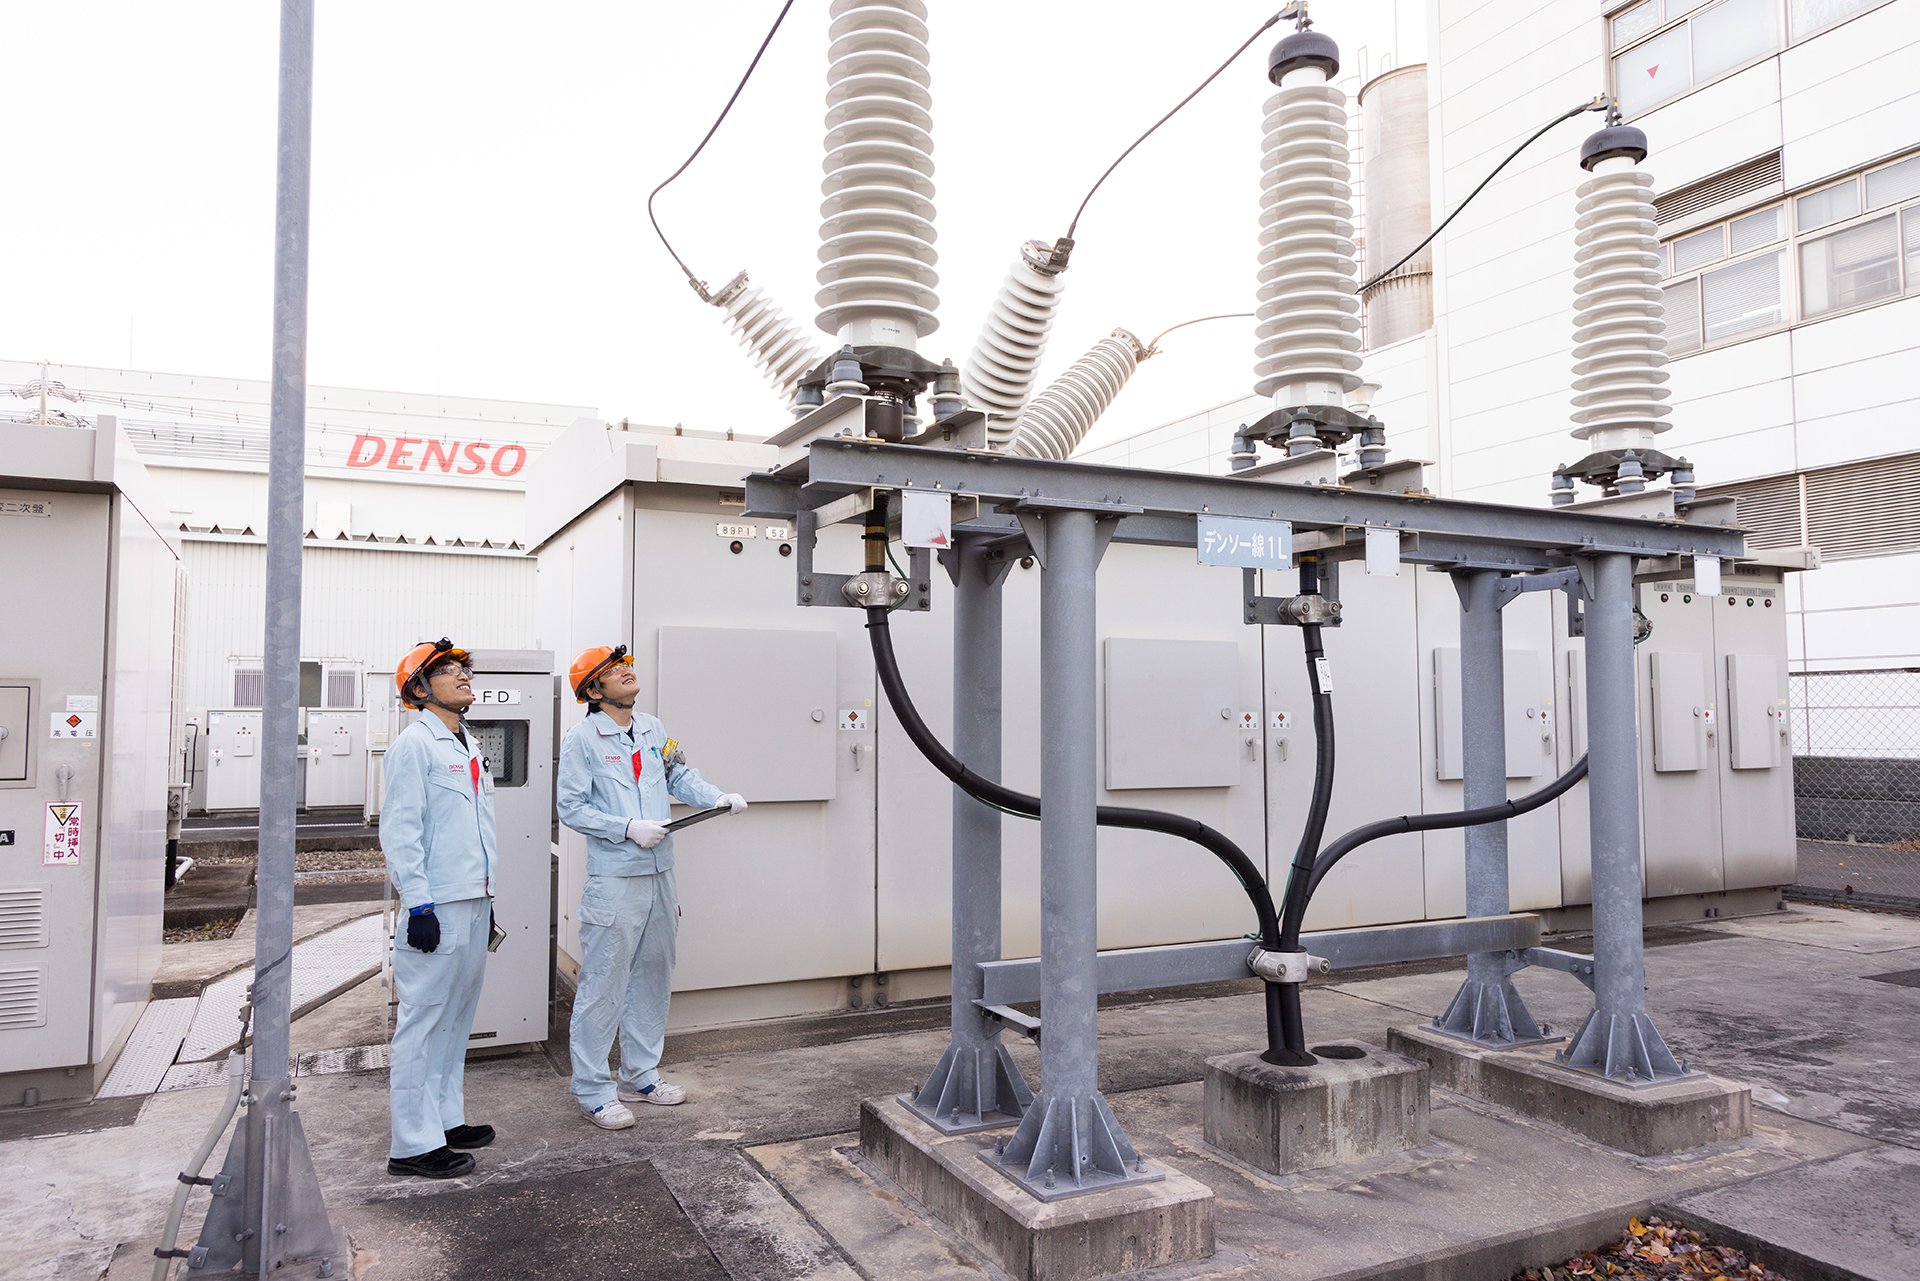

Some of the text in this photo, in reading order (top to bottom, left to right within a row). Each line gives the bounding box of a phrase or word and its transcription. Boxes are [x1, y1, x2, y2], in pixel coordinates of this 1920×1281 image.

[346, 434, 527, 477] DENSO
[722, 526, 750, 536] 89P1
[1204, 529, 1288, 560] デンソー線1L
